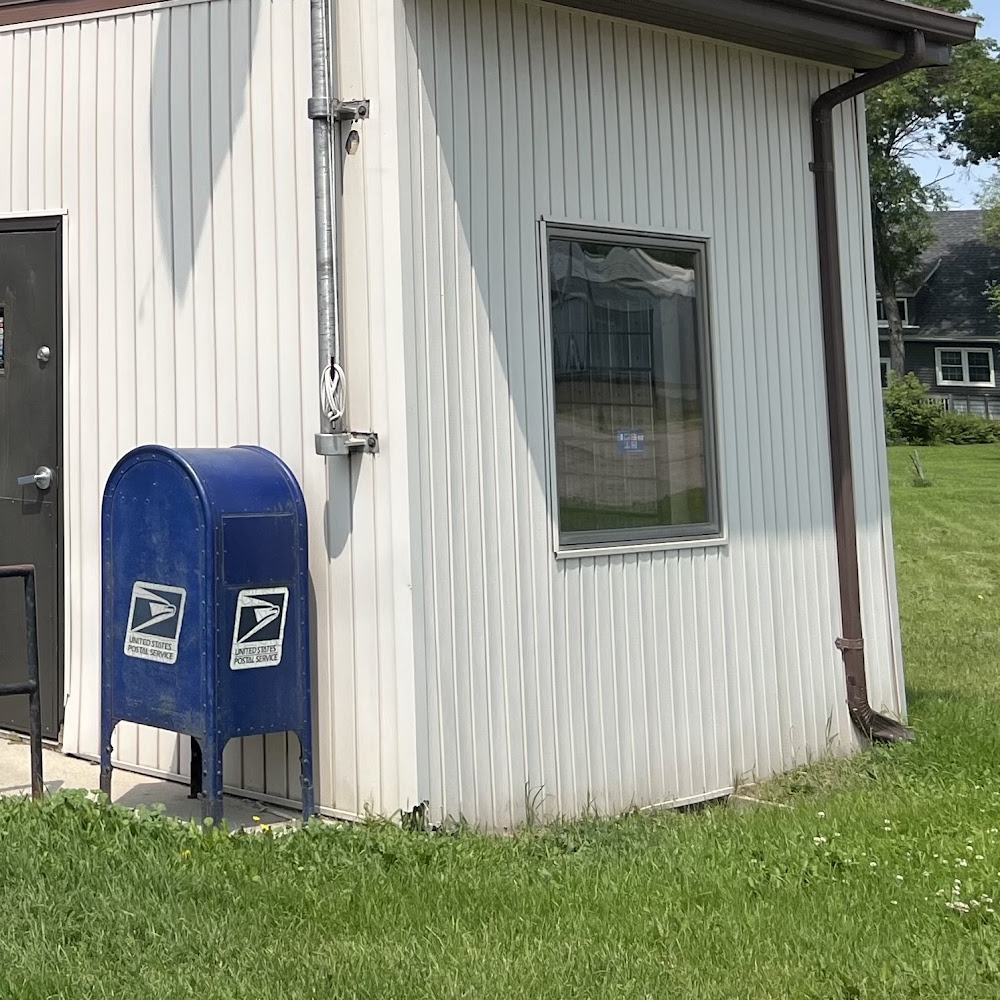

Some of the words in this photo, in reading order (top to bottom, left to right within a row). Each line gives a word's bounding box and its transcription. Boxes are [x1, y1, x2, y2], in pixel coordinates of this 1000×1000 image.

[128, 635, 151, 647] UNITED
[151, 640, 172, 650] STATES
[127, 644, 149, 655] POSTAL
[150, 649, 174, 660] SERVICE
[234, 646, 257, 656] UNITED
[257, 644, 277, 654] STATES
[233, 656, 255, 666] POSTAL
[255, 653, 278, 663] SERVICE
